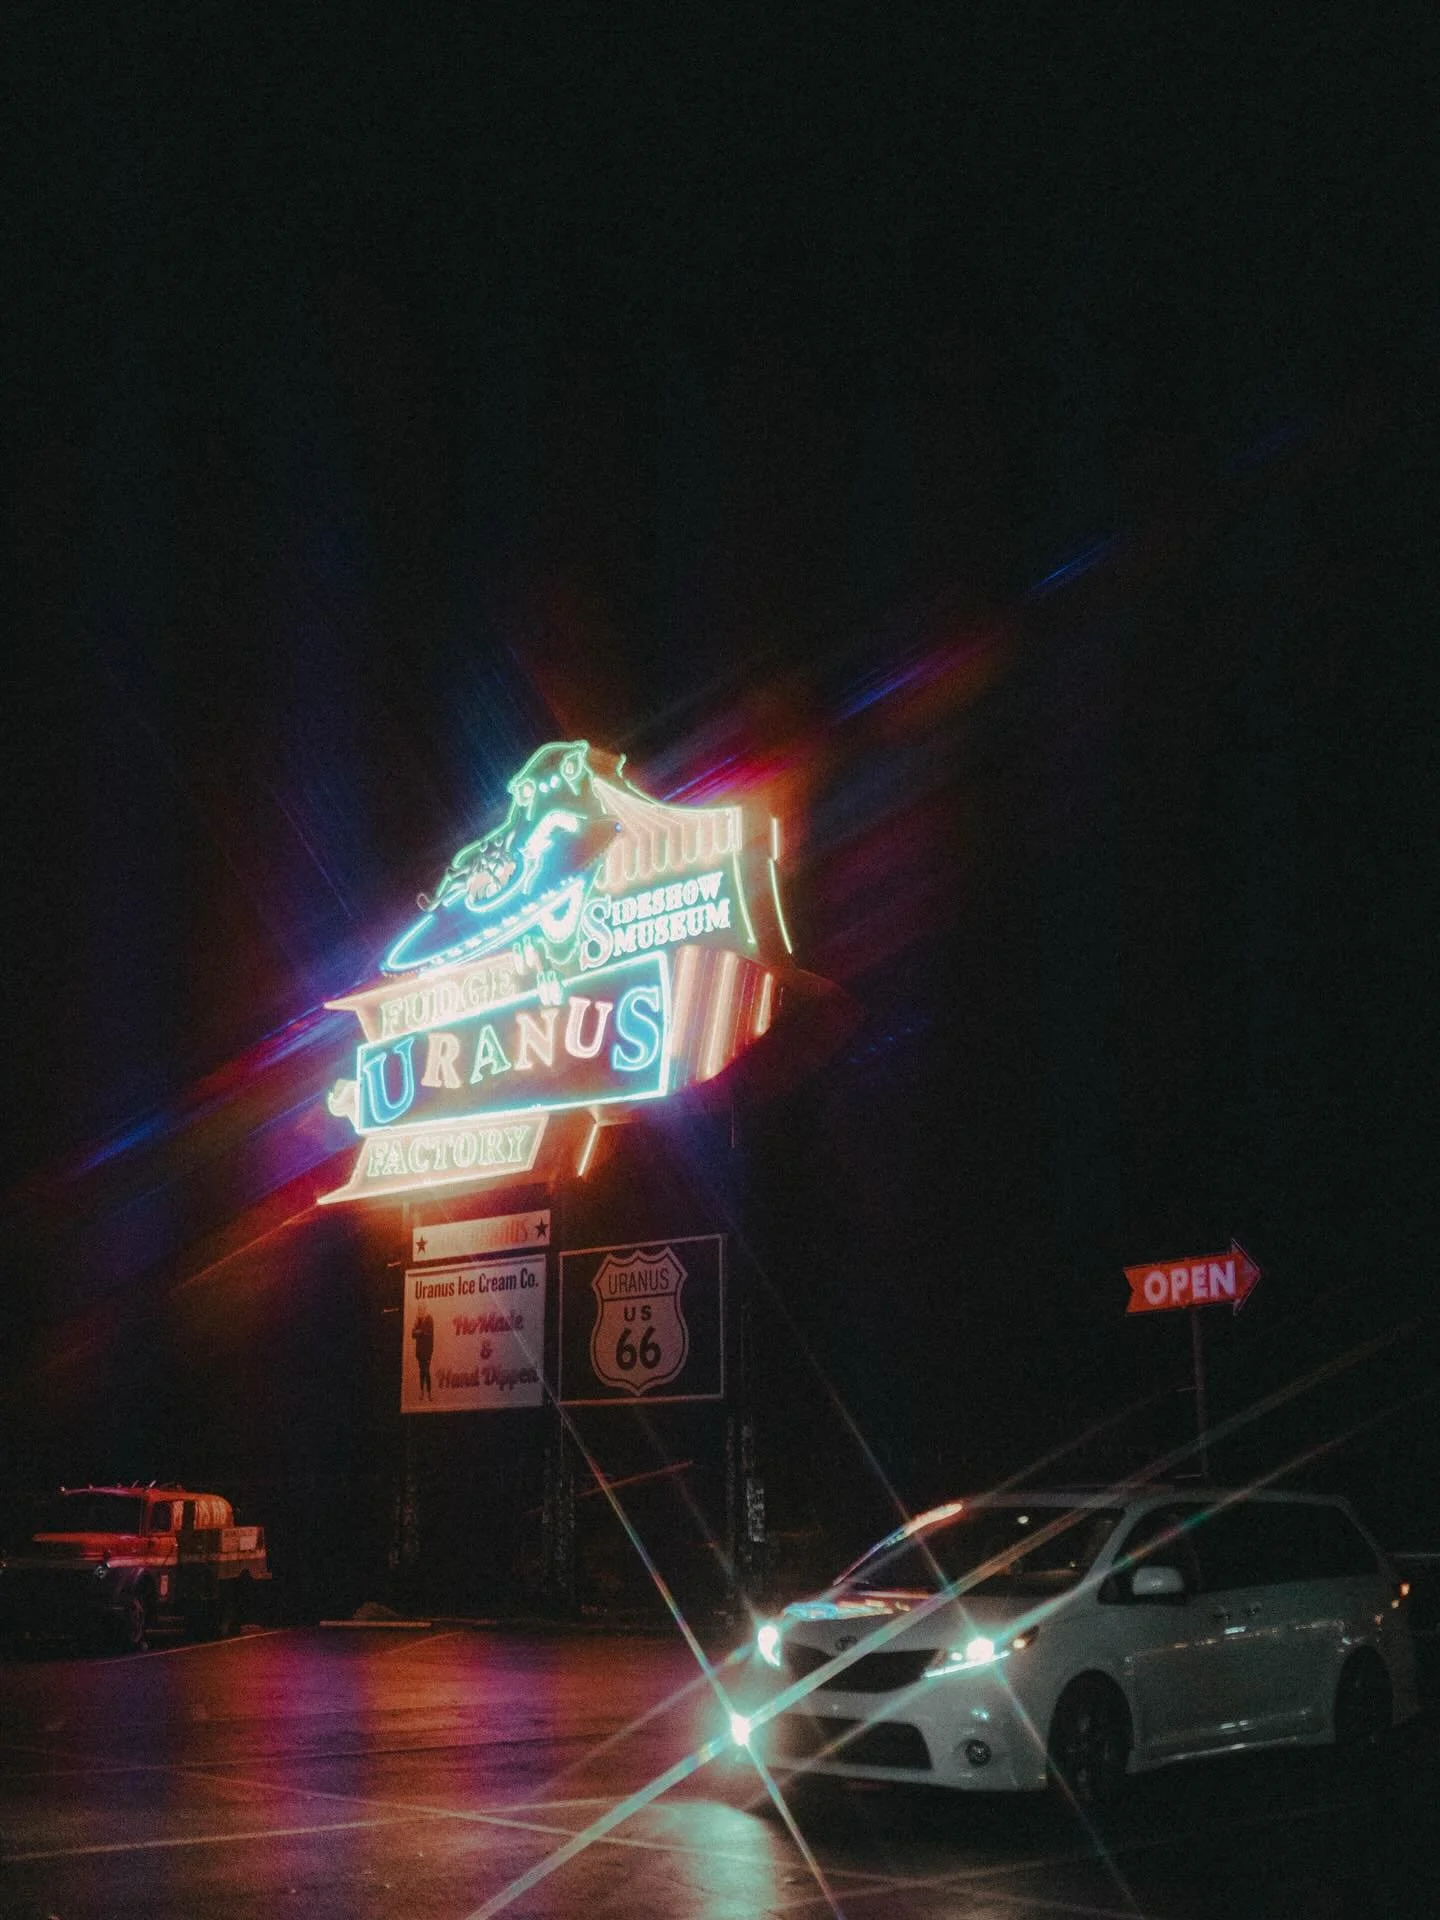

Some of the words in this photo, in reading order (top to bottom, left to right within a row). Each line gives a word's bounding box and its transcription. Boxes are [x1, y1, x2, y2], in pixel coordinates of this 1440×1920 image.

[580, 871, 724, 971] SIDESHOW
[612, 898, 731, 957] MUSEUM
[379, 963, 520, 1039] FUDGE
[362, 985, 662, 1125] URANUS
[366, 1124, 530, 1177] FACTORY
[415, 1280, 455, 1300] Uranus
[458, 1275, 476, 1295] Ice
[478, 1272, 517, 1293] Cream
[520, 1267, 540, 1289] Co.
[608, 1267, 670, 1295] URANUS
[1143, 1260, 1236, 1305] OPEN
[480, 1340, 493, 1360] &
[615, 1325, 662, 1371] 66
[435, 1367, 480, 1389] Hand
